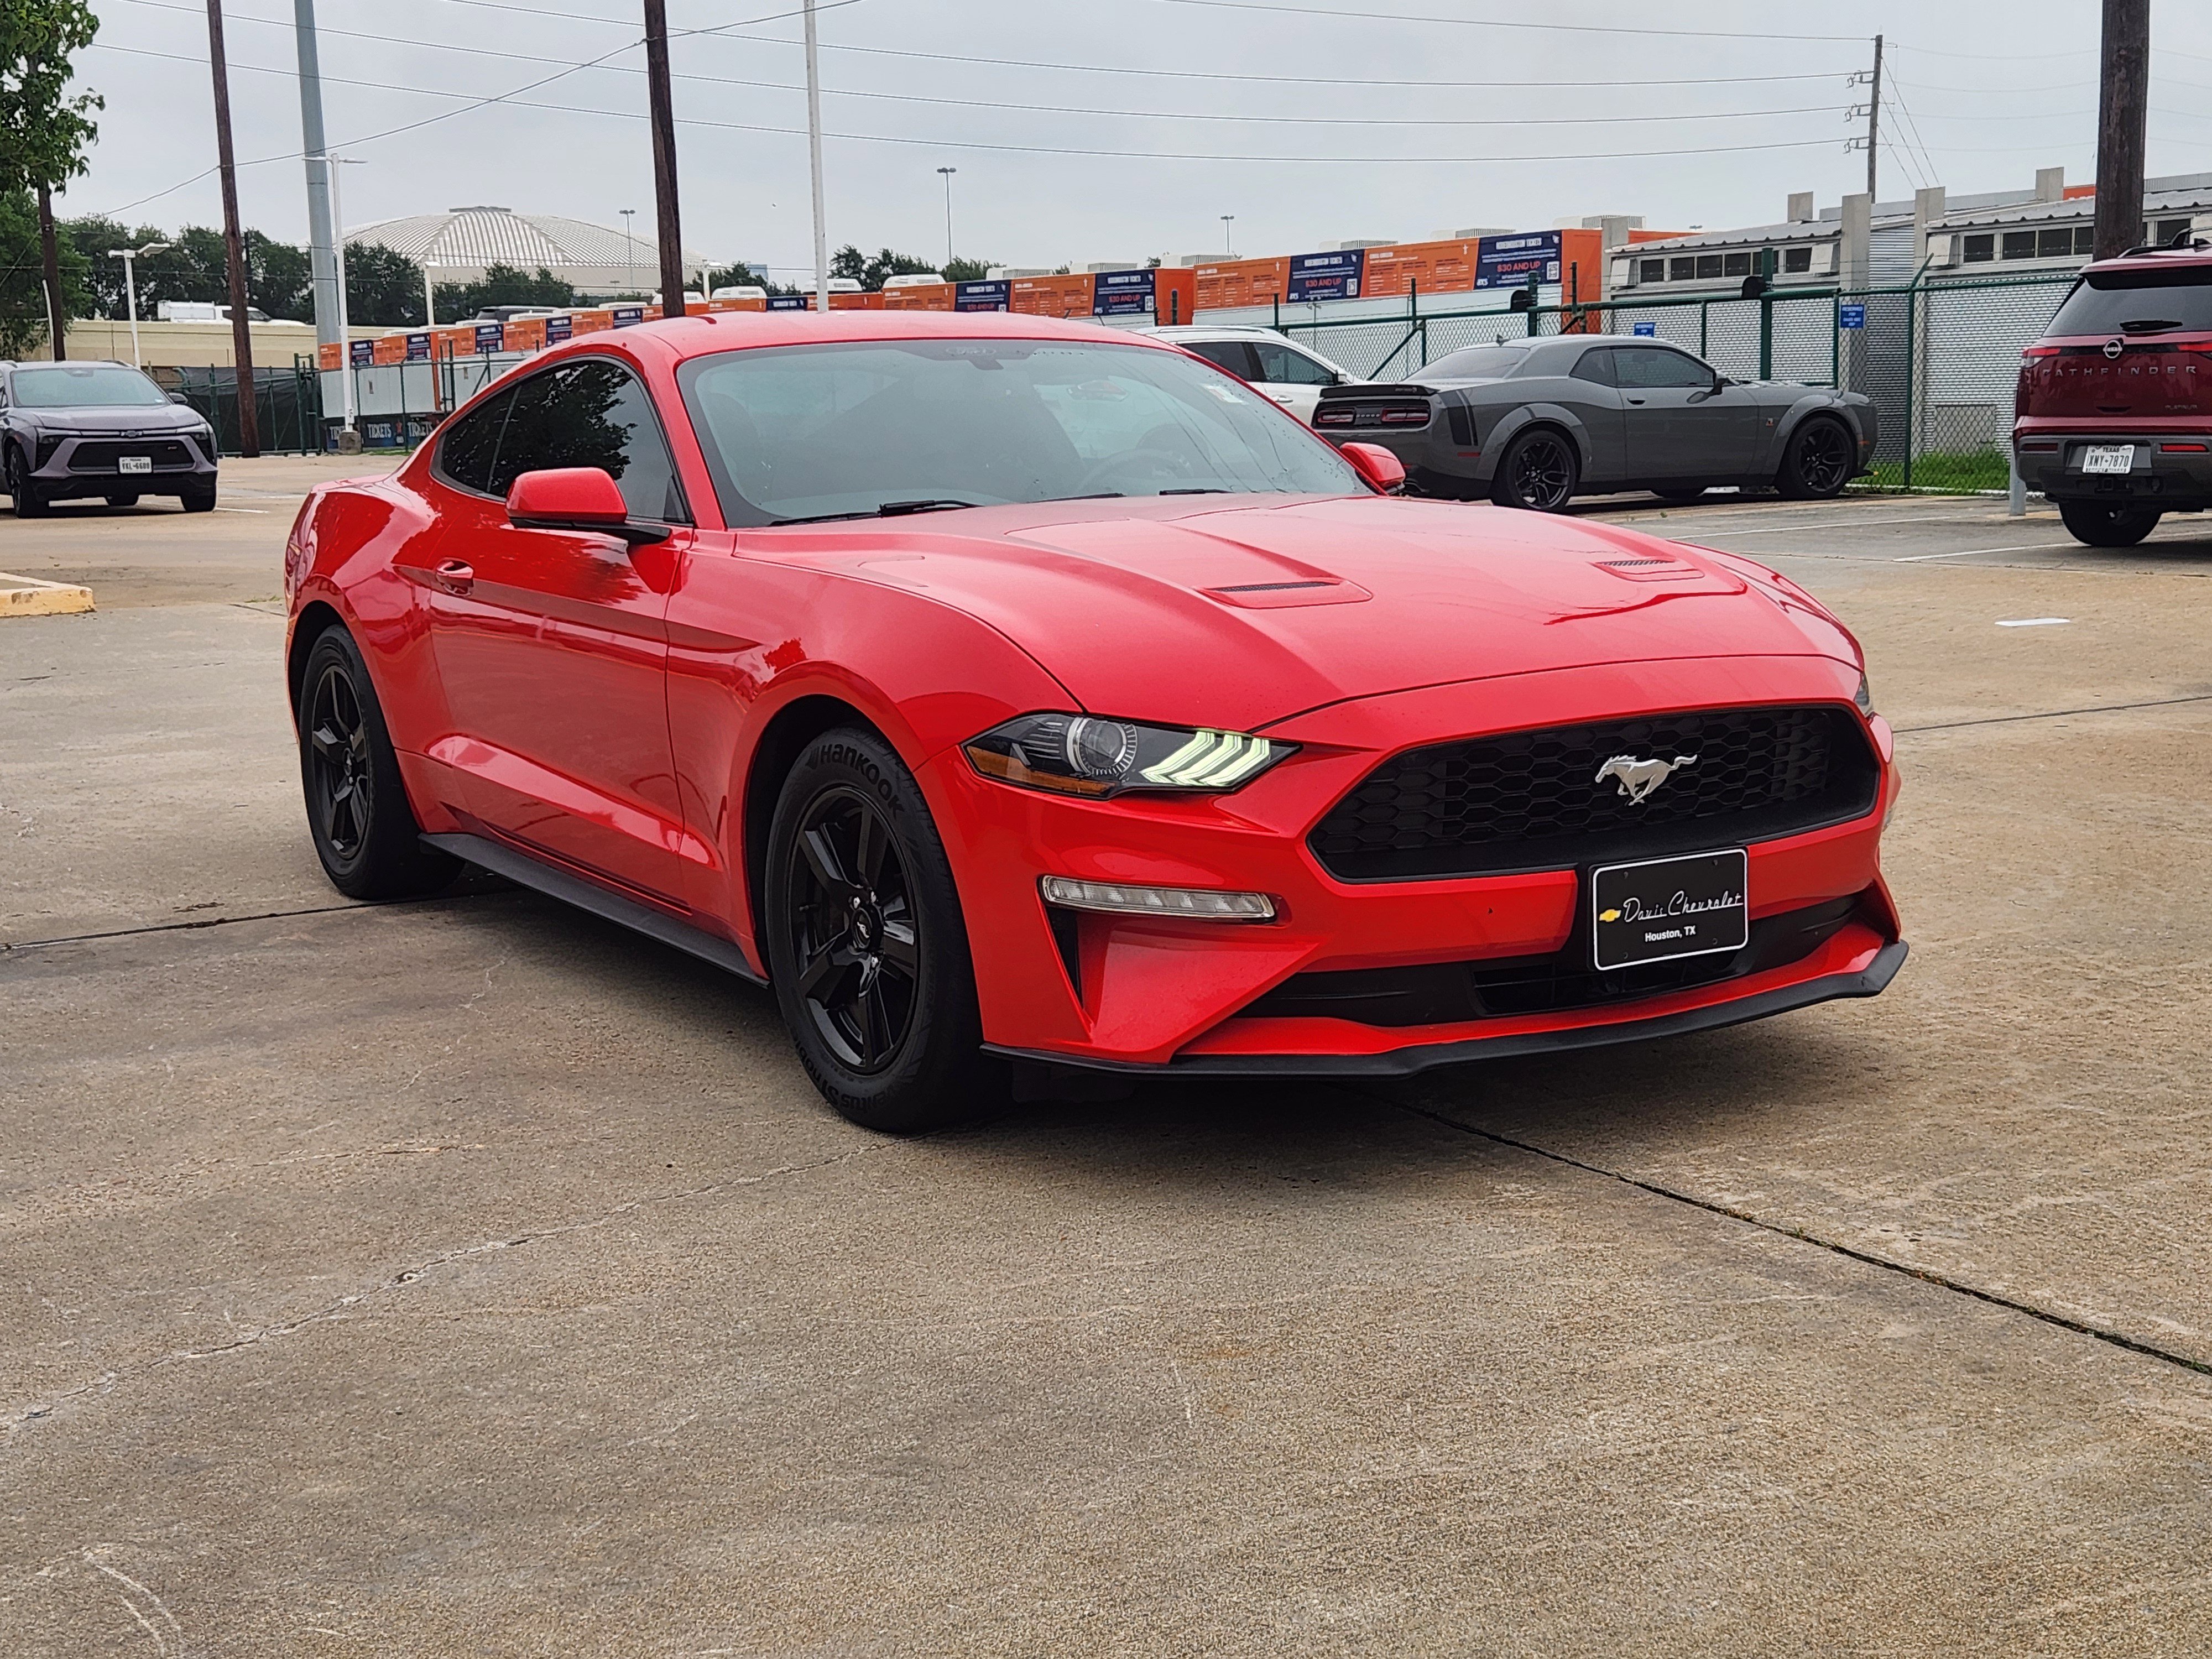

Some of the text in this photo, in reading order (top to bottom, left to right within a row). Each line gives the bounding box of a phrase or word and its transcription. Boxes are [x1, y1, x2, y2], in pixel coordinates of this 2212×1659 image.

[1497, 260, 1541, 272] $30 AND UP
[1318, 278, 1332, 286] AND
[2043, 366, 2196, 377] PATHFINDER
[367, 423, 392, 439] TICKETS
[1623, 890, 1744, 922] Davis Chevrolet
[1645, 925, 1697, 942] Houston, TX
